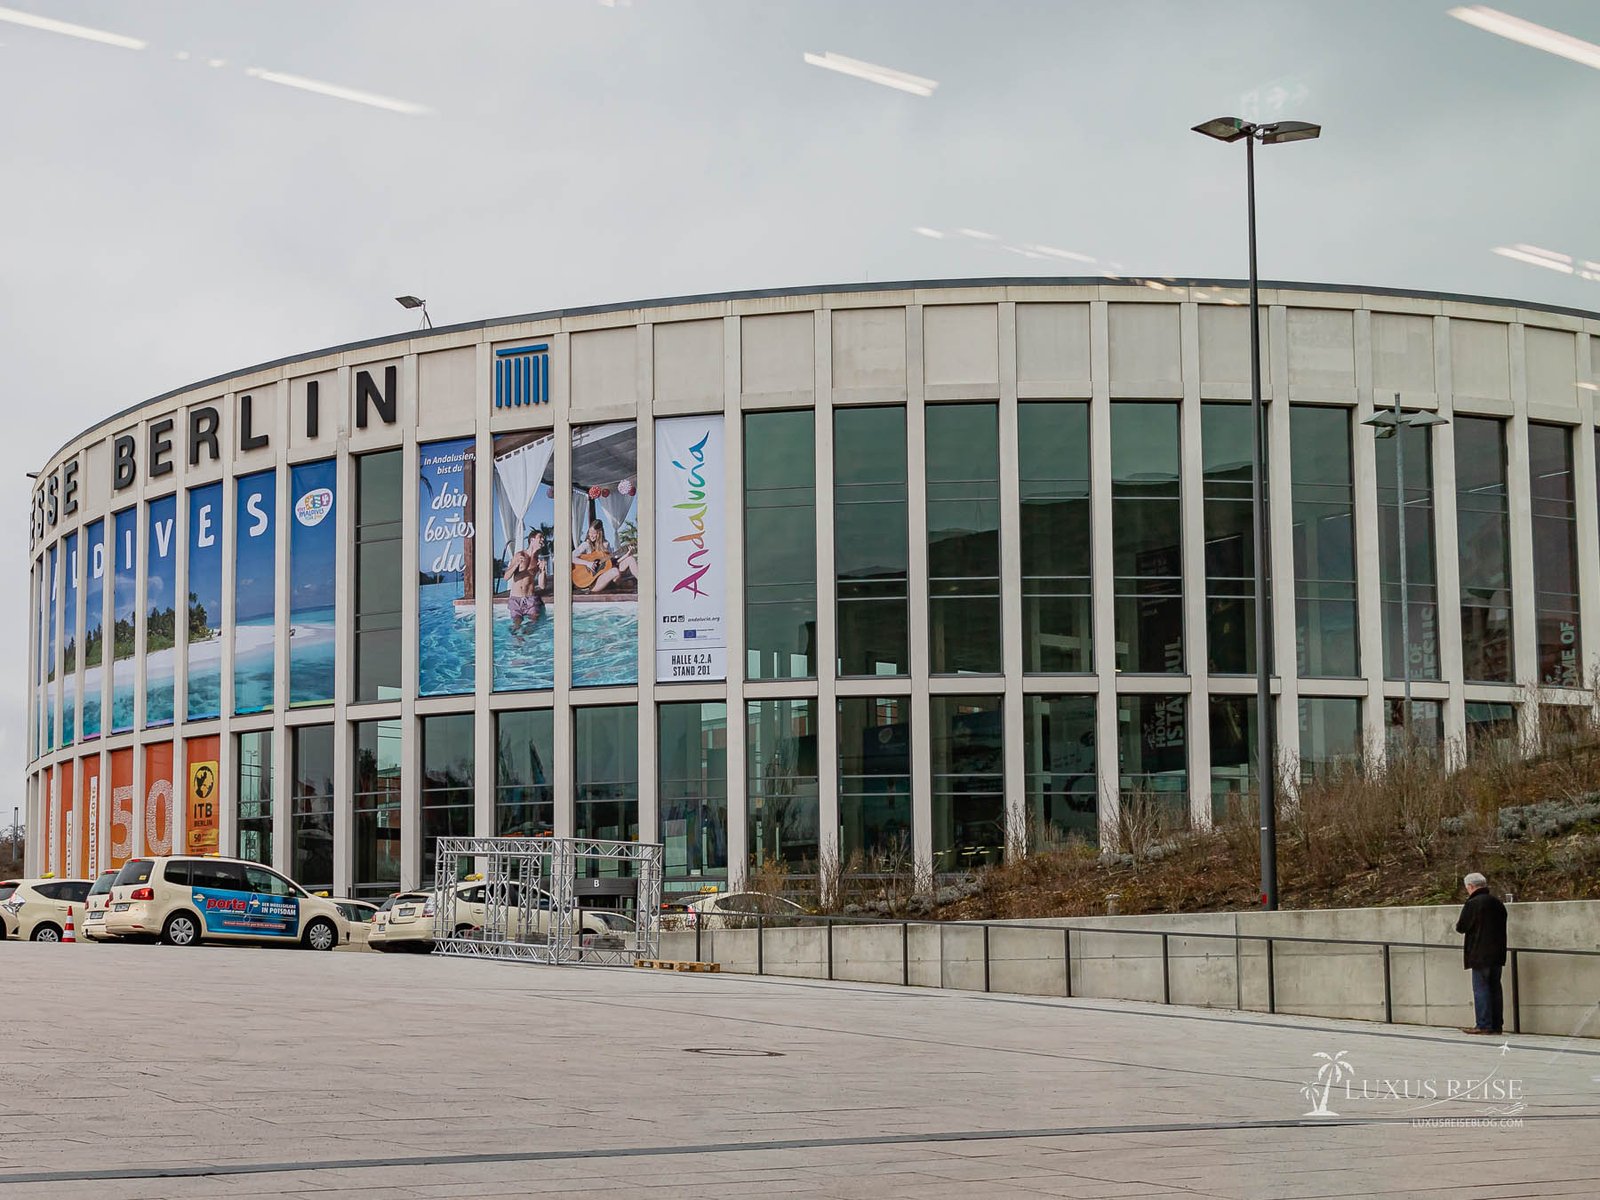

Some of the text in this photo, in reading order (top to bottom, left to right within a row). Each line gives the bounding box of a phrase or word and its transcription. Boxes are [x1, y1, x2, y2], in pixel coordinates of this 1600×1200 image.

[113, 366, 397, 490] BERLIN
[424, 452, 476, 466] In Andalusien,
[437, 464, 463, 475] bist du
[432, 481, 468, 510] dein
[424, 513, 475, 542] bestes
[432, 540, 466, 572] du
[671, 653, 712, 665] HALLE 4.2.A
[1560, 621, 1576, 687] OME OF
[673, 665, 711, 676] STAND 201
[194, 802, 213, 819] ITB
[194, 819, 213, 827] BERLIN
[206, 898, 246, 910] porta
[270, 907, 296, 916] POTSDAM
